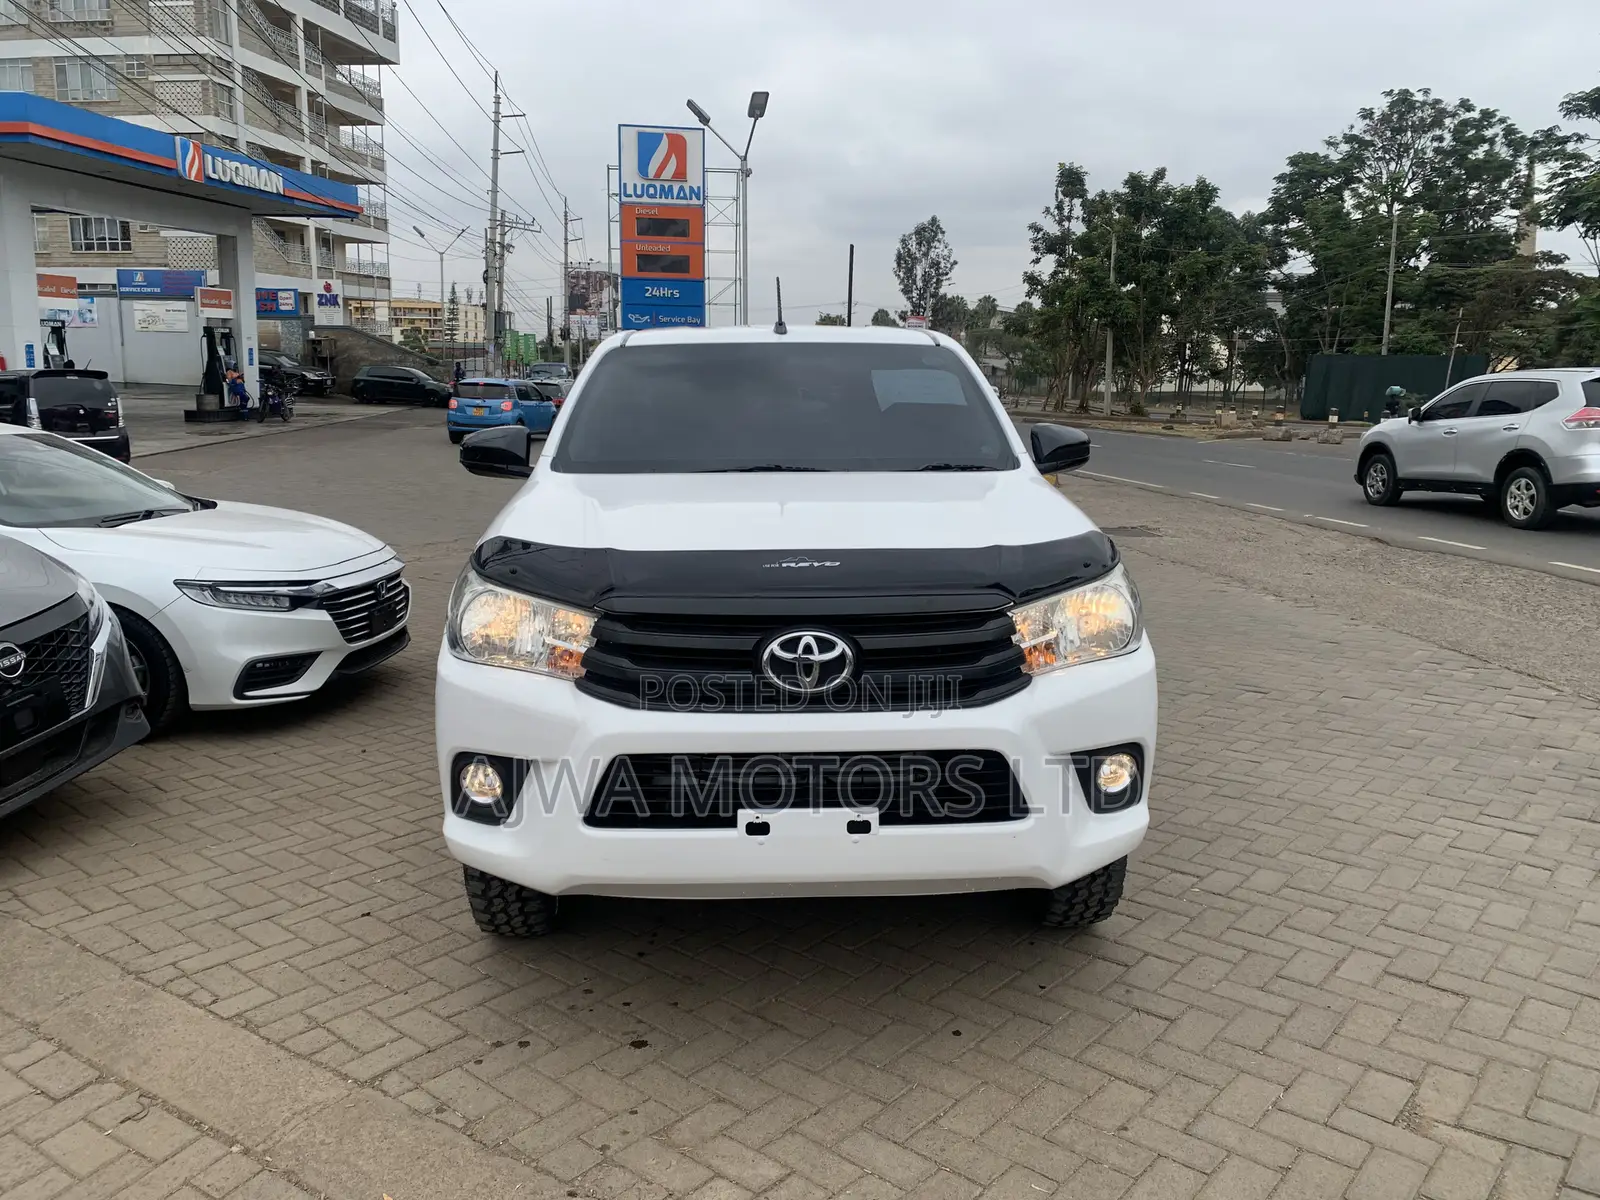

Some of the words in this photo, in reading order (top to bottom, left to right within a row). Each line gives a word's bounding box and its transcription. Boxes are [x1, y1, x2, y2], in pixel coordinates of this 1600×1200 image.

[204, 153, 284, 195] LUQMAN
[622, 182, 702, 201] LUQMAN
[635, 207, 659, 215] Diesel
[635, 243, 671, 252] Unleaded
[644, 286, 680, 298] 24Hrs
[316, 294, 341, 306] ZNK
[658, 314, 686, 324] Service
[687, 316, 701, 325] Bay
[0, 653, 26, 668] ISSAN
